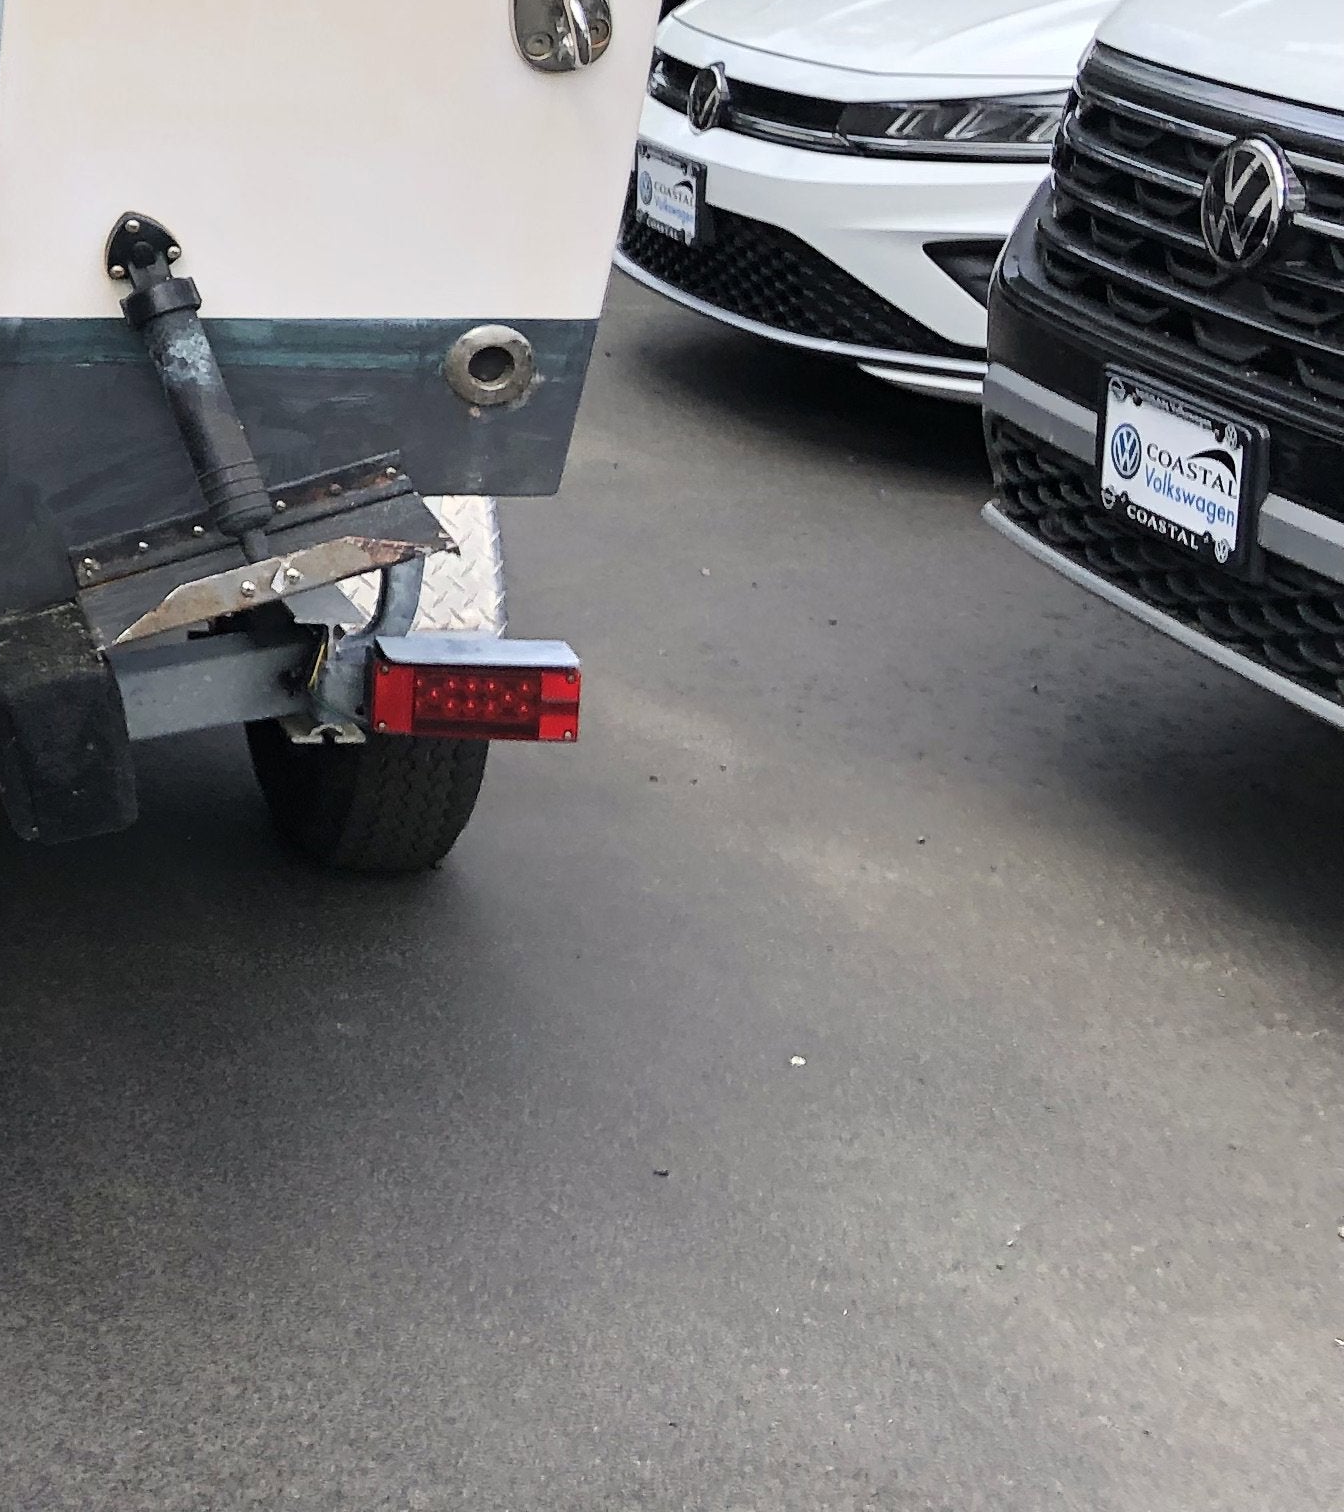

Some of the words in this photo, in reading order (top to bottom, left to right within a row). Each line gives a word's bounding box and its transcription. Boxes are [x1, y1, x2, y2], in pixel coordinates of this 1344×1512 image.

[1145, 463, 1235, 528] Volkswagen
[1146, 443, 1238, 500] COASTAL
[1126, 503, 1199, 551] COASTAL
